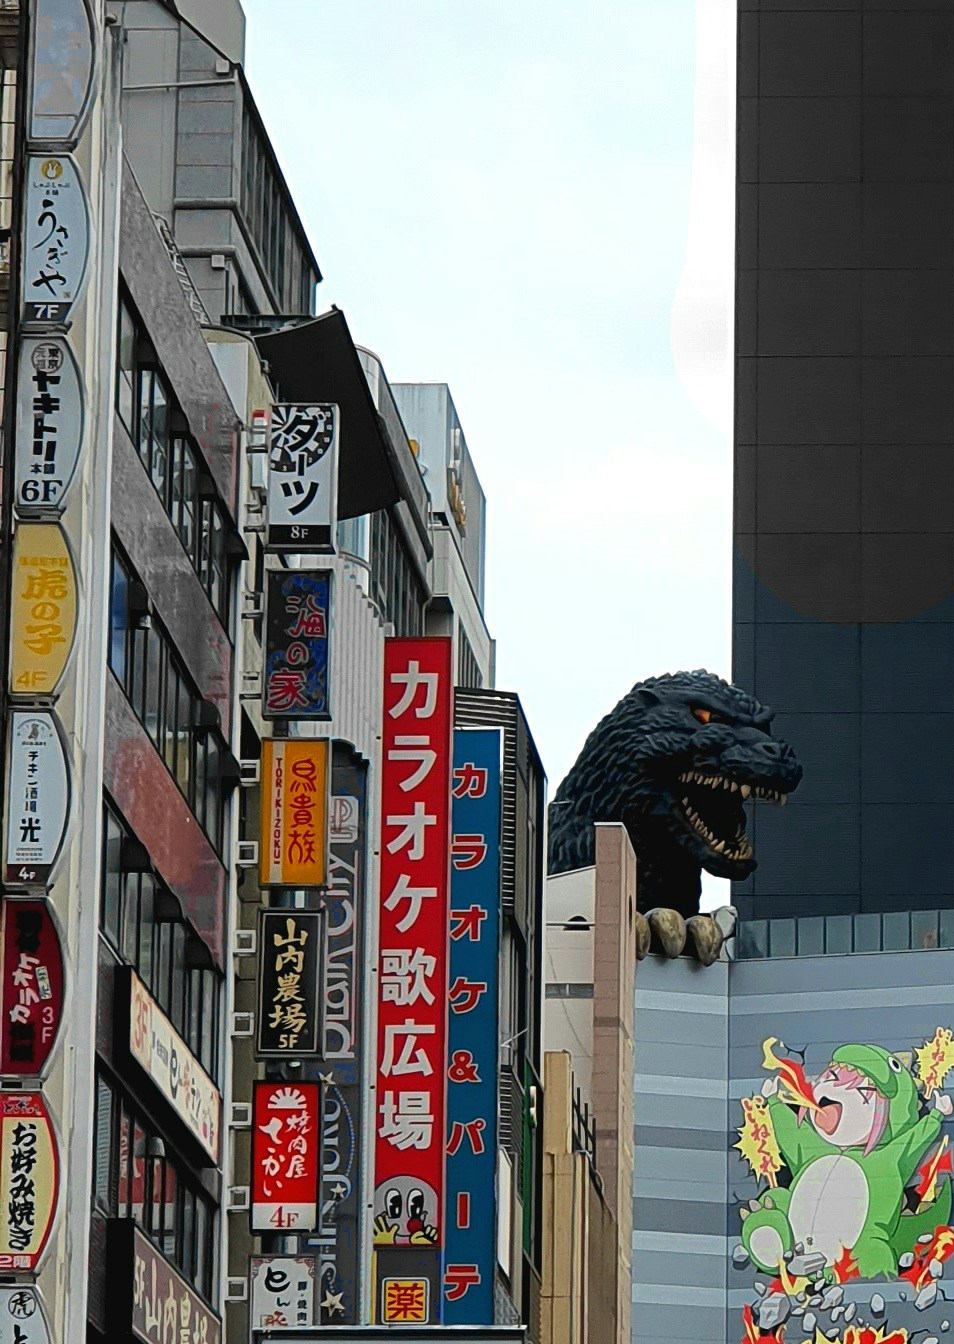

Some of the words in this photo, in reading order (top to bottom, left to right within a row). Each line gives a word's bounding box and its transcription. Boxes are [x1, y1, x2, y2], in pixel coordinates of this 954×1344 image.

[32, 198, 69, 297] うさぎや
[33, 304, 60, 320] 7F
[31, 370, 62, 462] ヤキトリ
[21, 479, 63, 502] 6F
[281, 411, 327, 516] ダーツ
[290, 525, 309, 540] 8F
[21, 568, 69, 656] 虎の子
[16, 670, 48, 688] 4F
[20, 816, 41, 843] 光
[289, 758, 317, 864] 鳥貴族
[18, 866, 36, 881] 4F
[378, 659, 440, 1151] カラオケ歌広場
[268, 917, 308, 1034] 山内農場
[277, 1033, 299, 1049] 5F
[259, 1116, 284, 1197] さかい
[285, 1109, 313, 1179] 焼肉屋
[8, 1121, 38, 1252] お好み焼き
[269, 1205, 300, 1228] 4F
[386, 1278, 426, 1322] 薬
